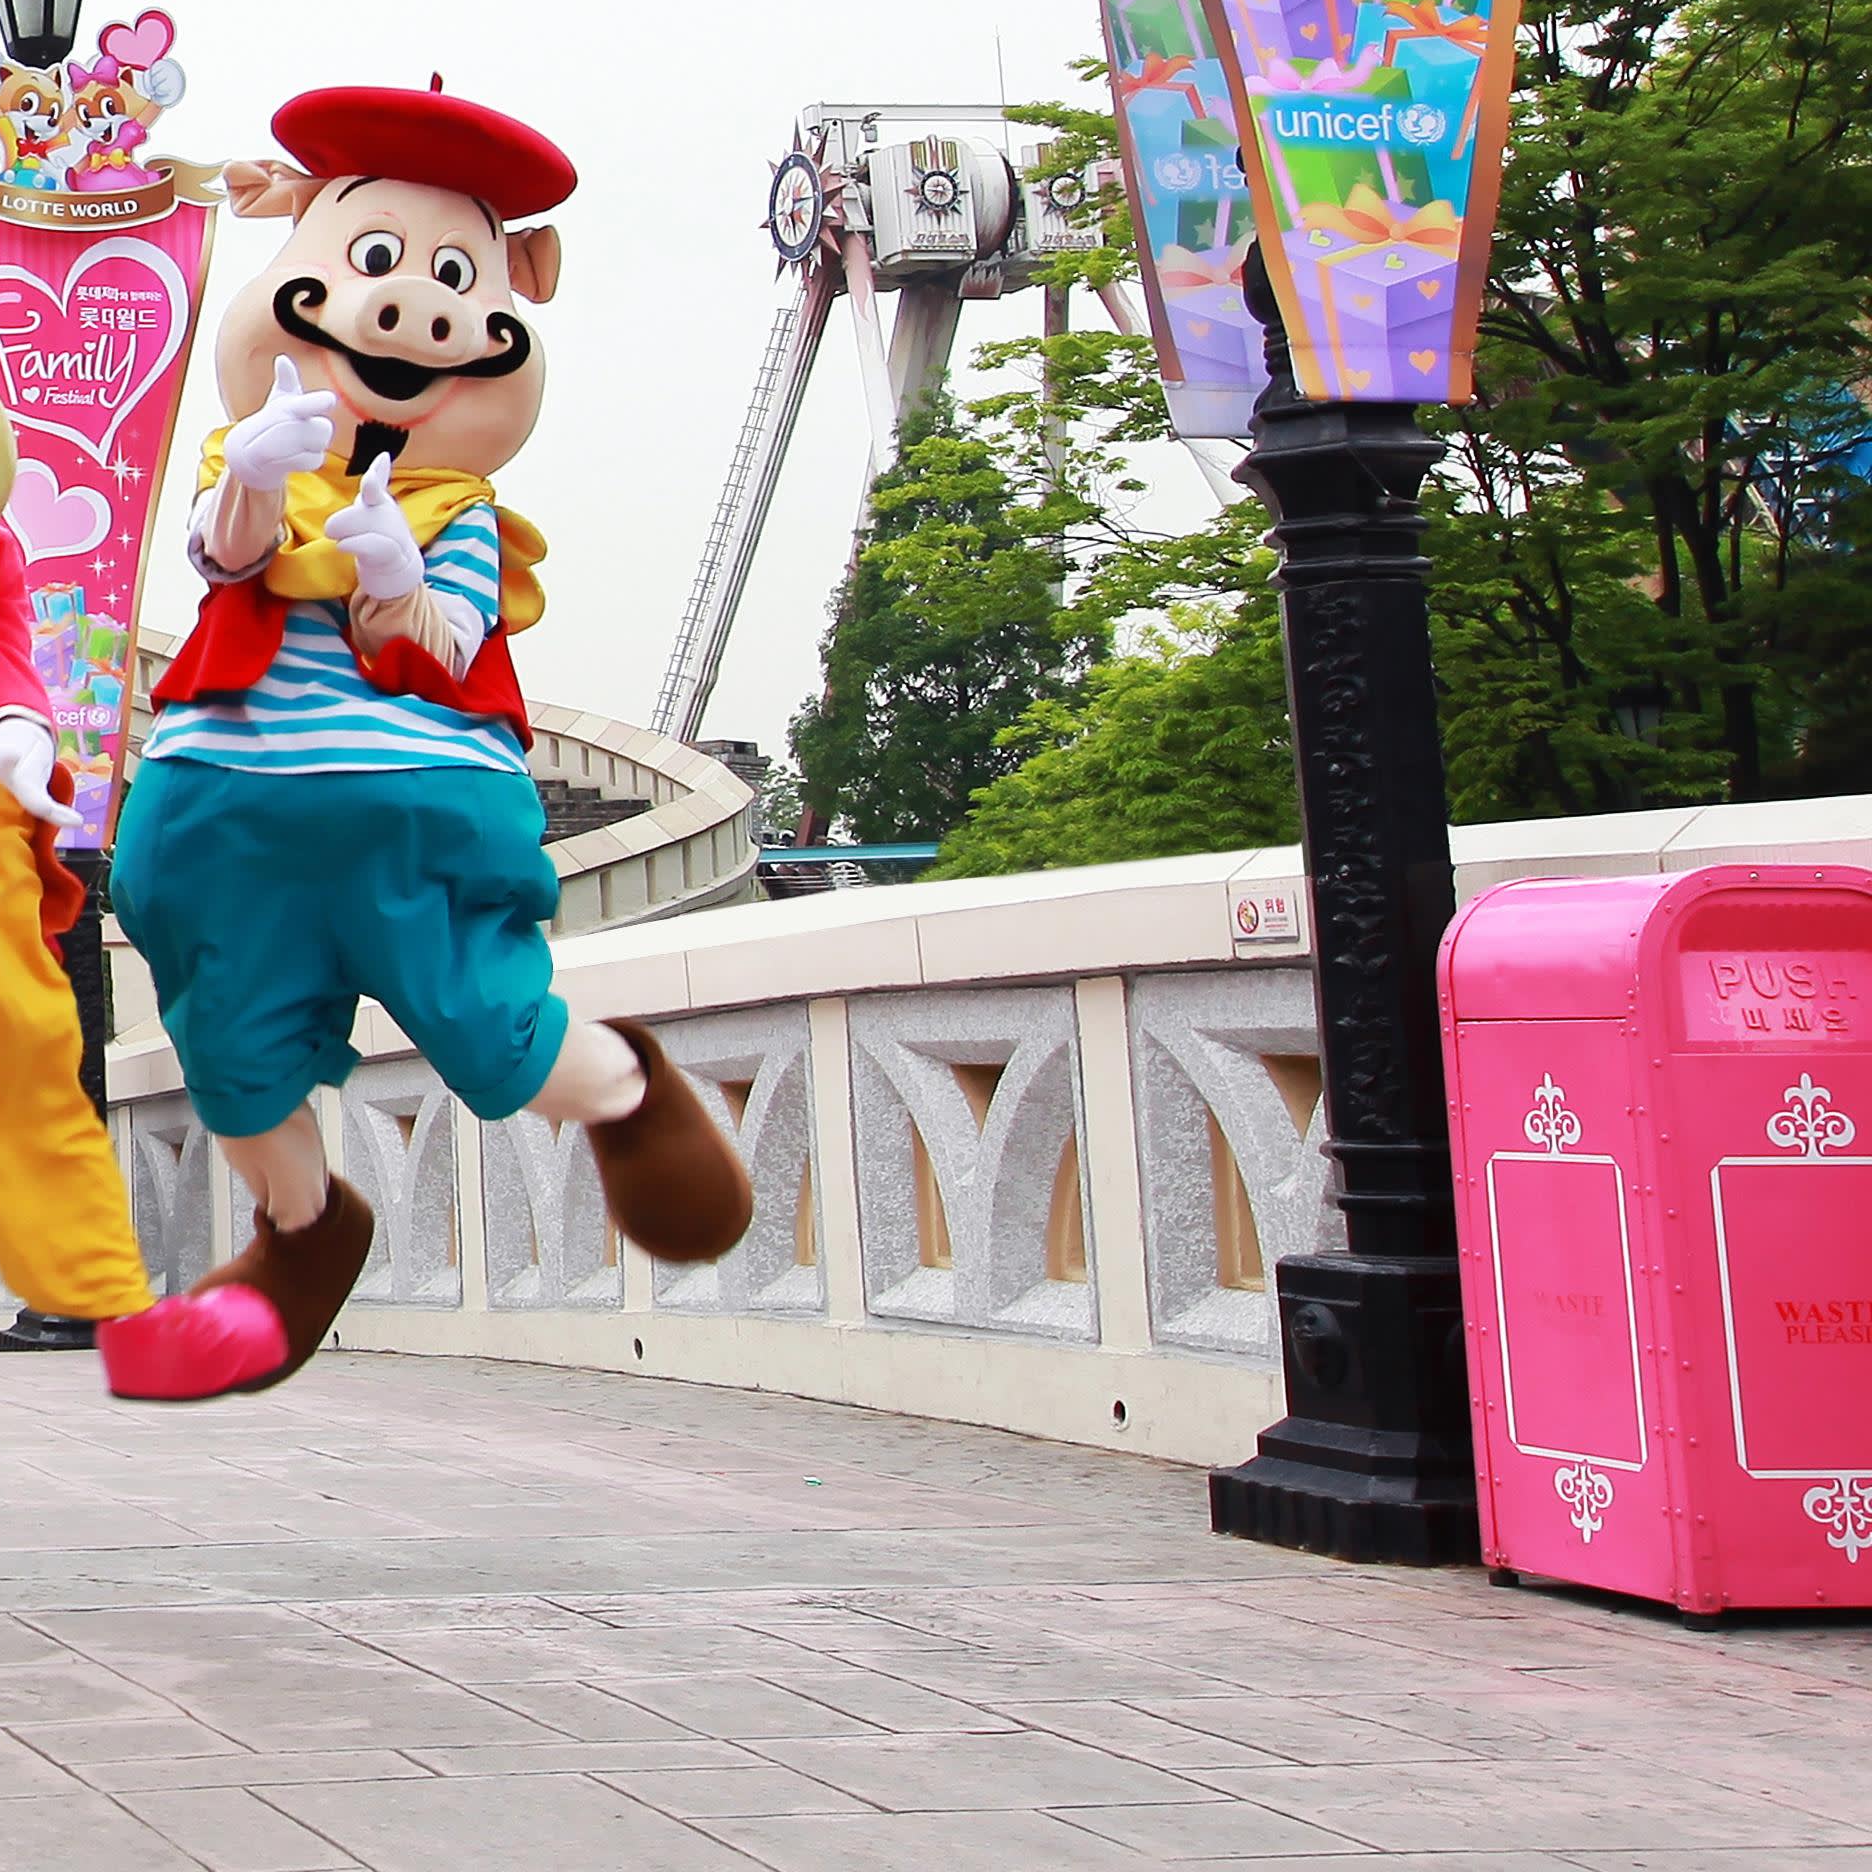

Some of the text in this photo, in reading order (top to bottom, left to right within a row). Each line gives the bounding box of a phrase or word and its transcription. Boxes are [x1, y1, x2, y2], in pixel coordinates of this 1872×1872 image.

[1275, 102, 1393, 142] unicef
[2, 195, 139, 218] LOTTE WORLD
[43, 386, 96, 405] Festival
[51, 705, 87, 726] icef
[1709, 960, 1859, 1000] PUSH
[1775, 1300, 1872, 1323] WAST
